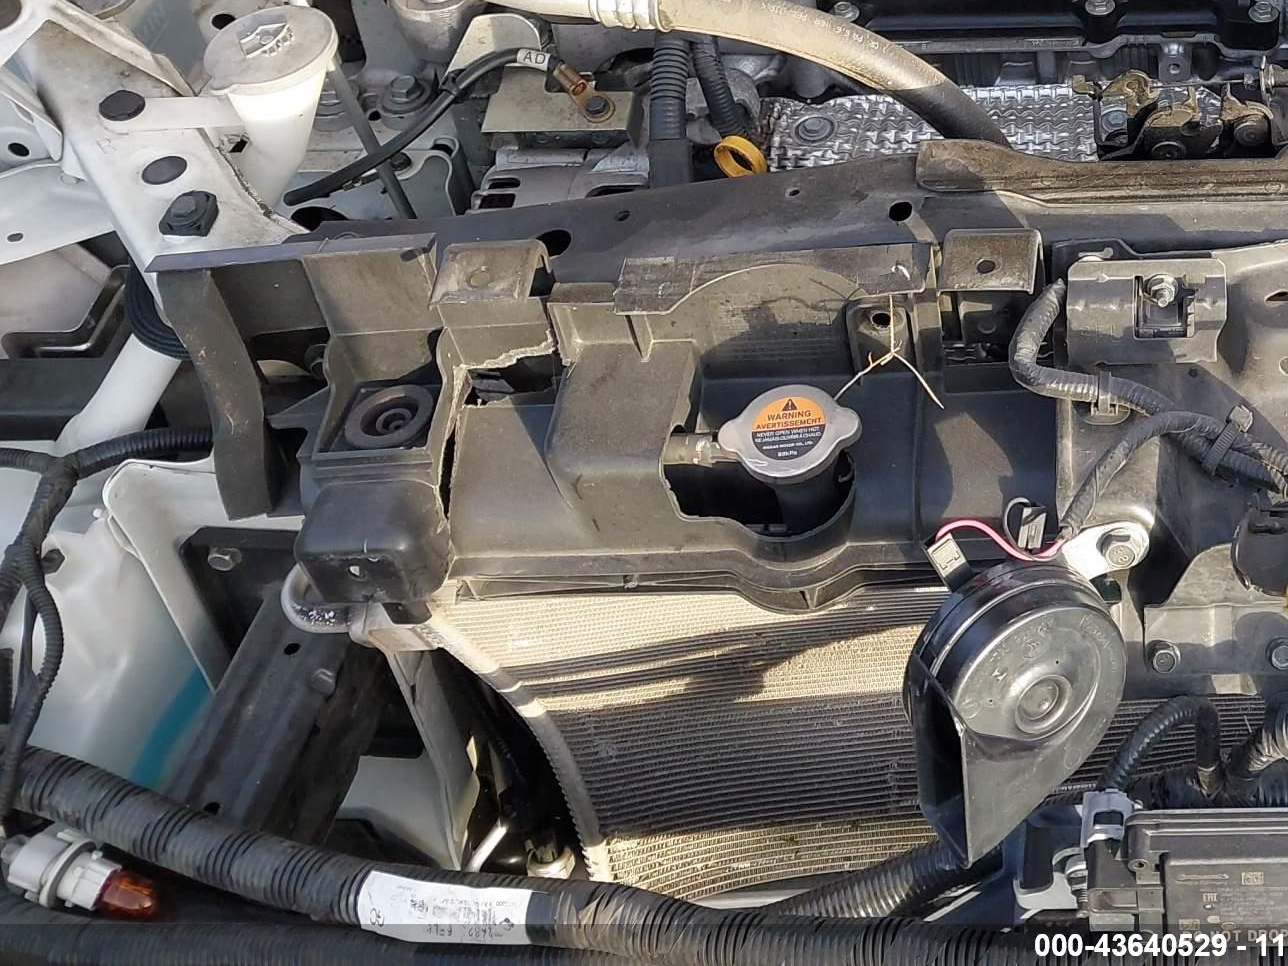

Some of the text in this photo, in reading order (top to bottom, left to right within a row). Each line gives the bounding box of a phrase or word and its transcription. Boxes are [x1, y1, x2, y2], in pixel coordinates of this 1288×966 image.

[523, 51, 546, 64] AD
[767, 410, 811, 421] WARNING
[756, 417, 822, 429] AVERTISSEMENT
[756, 430, 775, 438] NEVER
